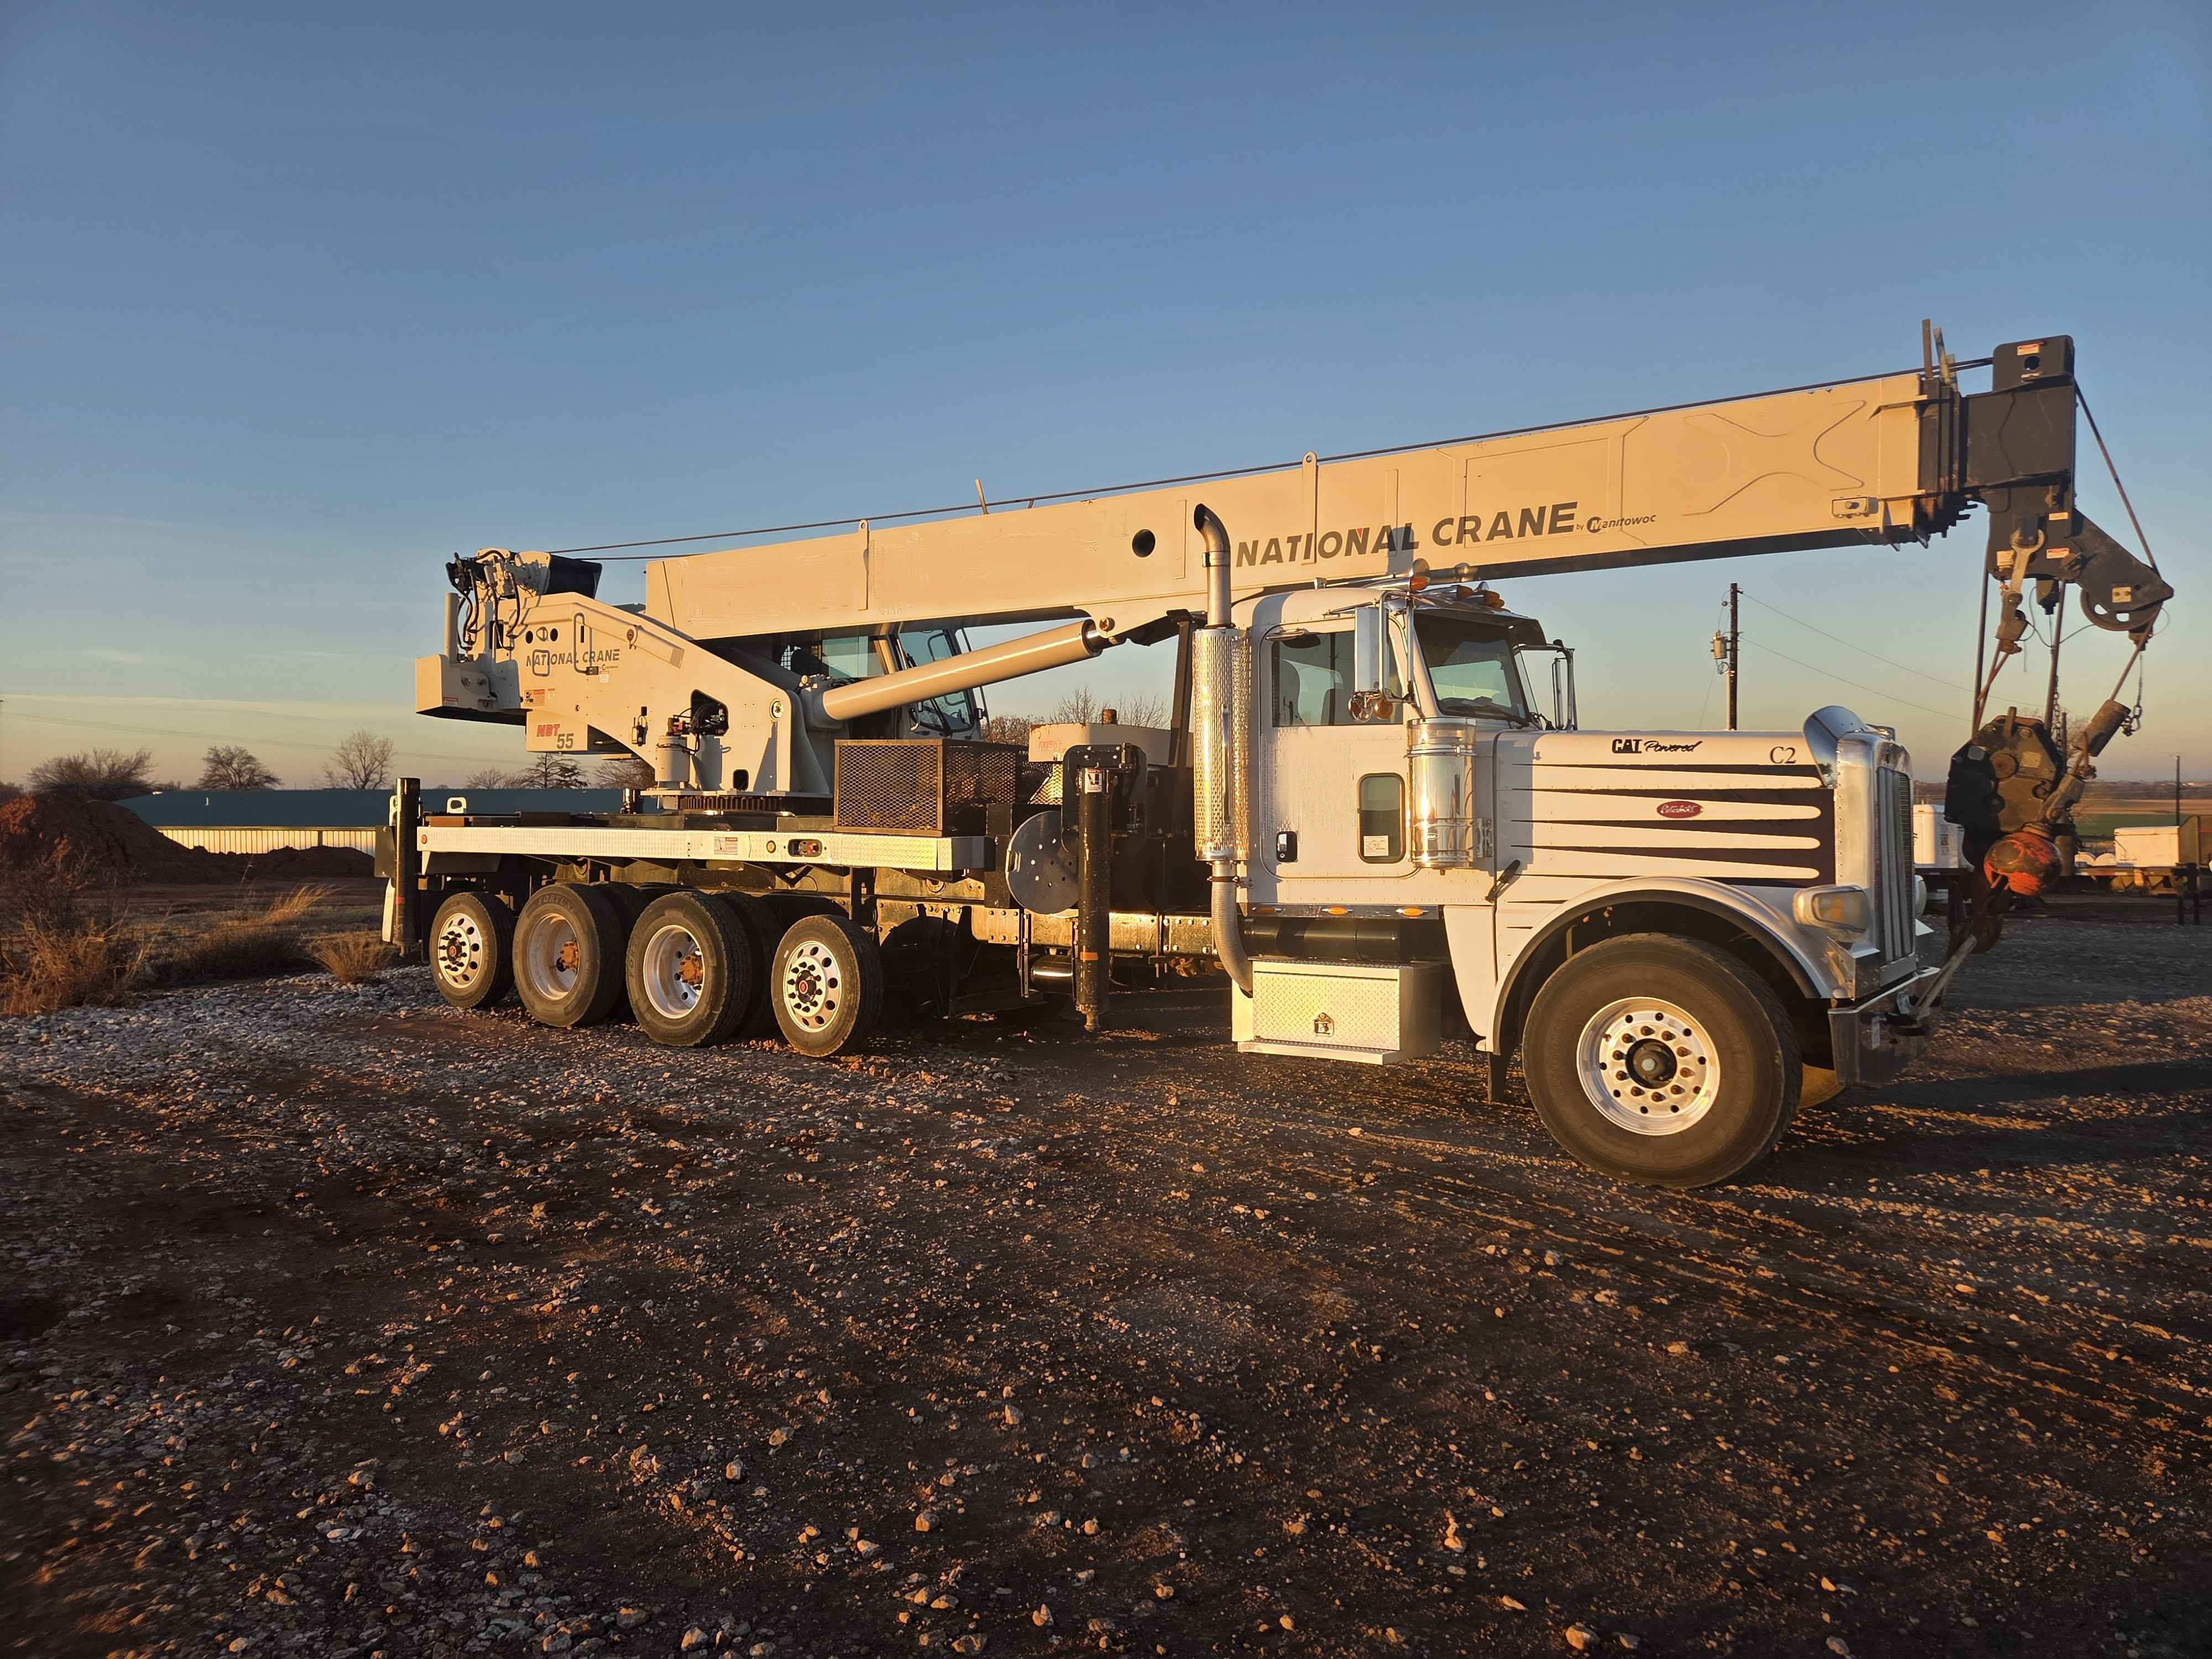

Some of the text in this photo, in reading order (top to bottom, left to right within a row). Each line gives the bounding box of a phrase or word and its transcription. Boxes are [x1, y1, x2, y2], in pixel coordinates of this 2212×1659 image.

[1576, 515, 1657, 533] by Manitowoc
[1236, 502, 1578, 567] NATIONAL CRANE
[582, 649, 620, 663] CRANE
[536, 724, 560, 737] NBT
[556, 733, 574, 749] 55
[1039, 740, 1062, 751] NBT
[1612, 739, 1703, 754] CAT Powered
[1770, 747, 1796, 764] C2
